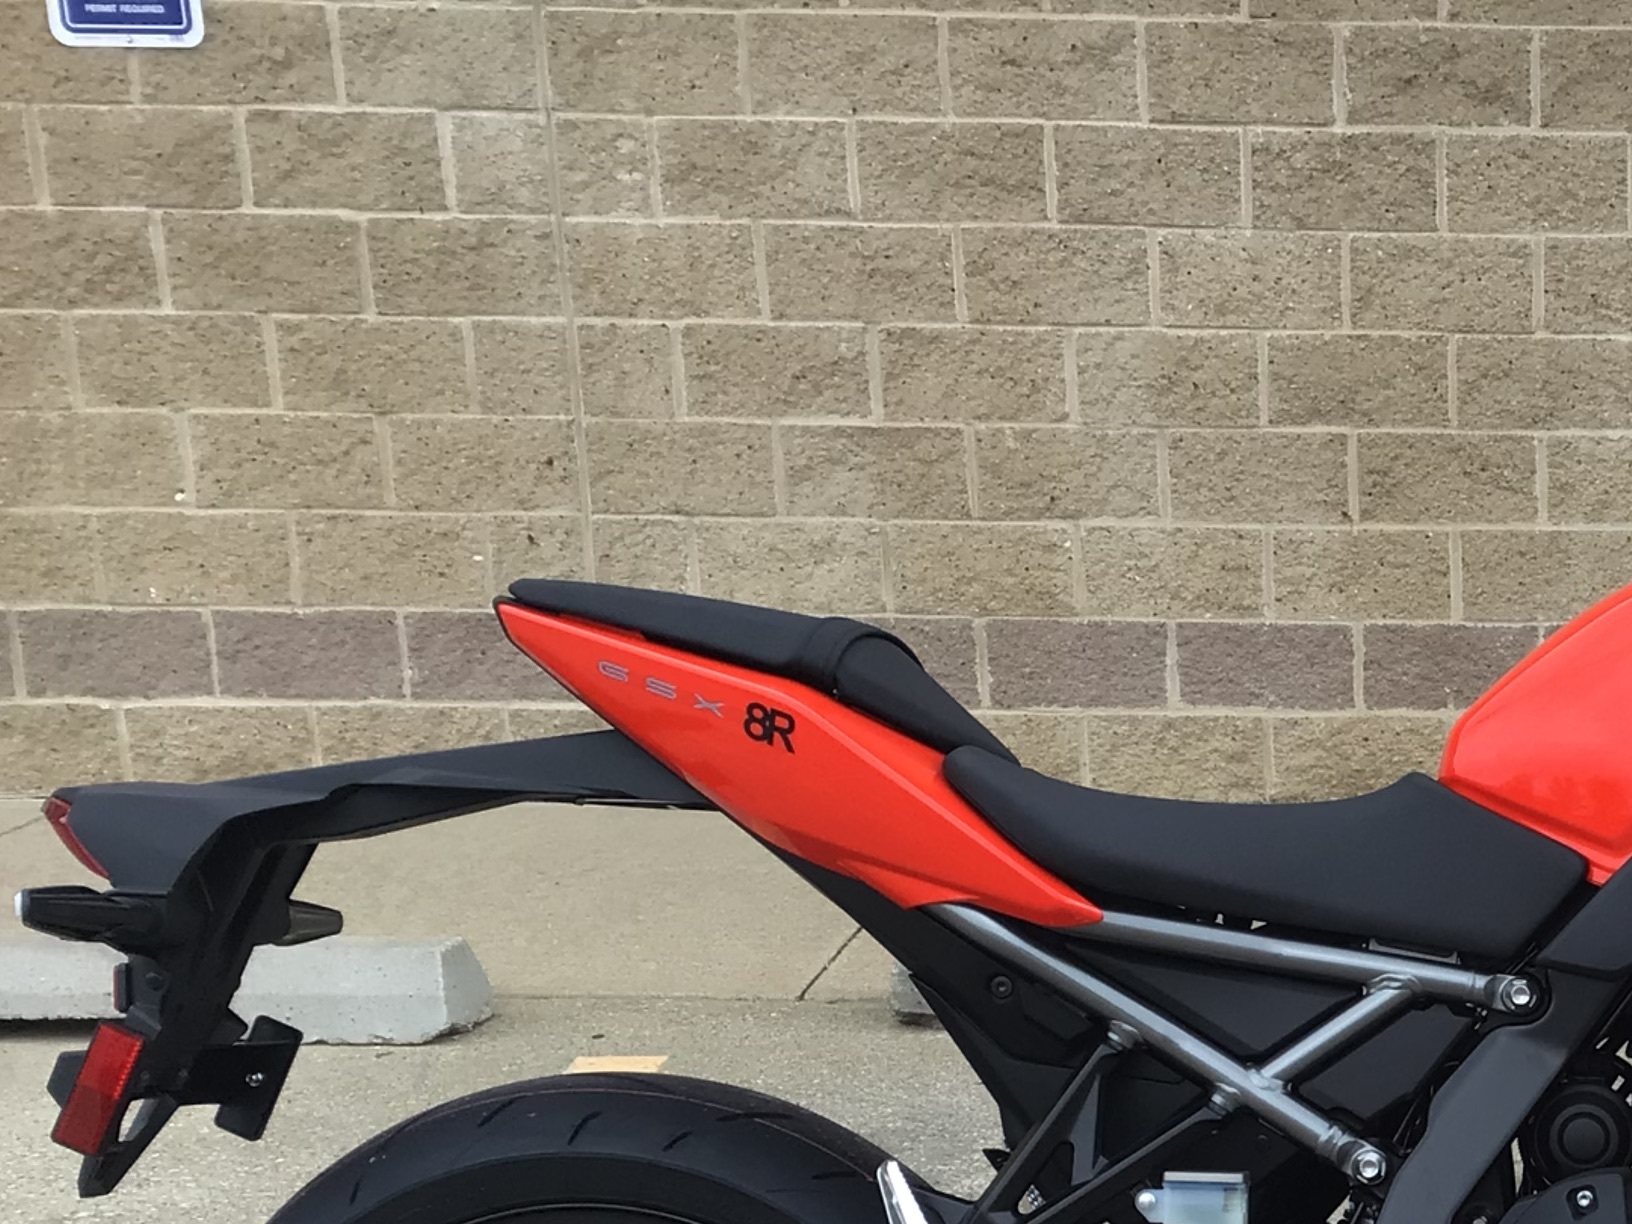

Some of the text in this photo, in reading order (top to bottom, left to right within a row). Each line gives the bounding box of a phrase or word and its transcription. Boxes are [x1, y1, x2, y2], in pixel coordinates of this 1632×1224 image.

[84, 4, 165, 13] PERMIT REQUIRED
[598, 660, 796, 755] GSX 8R
